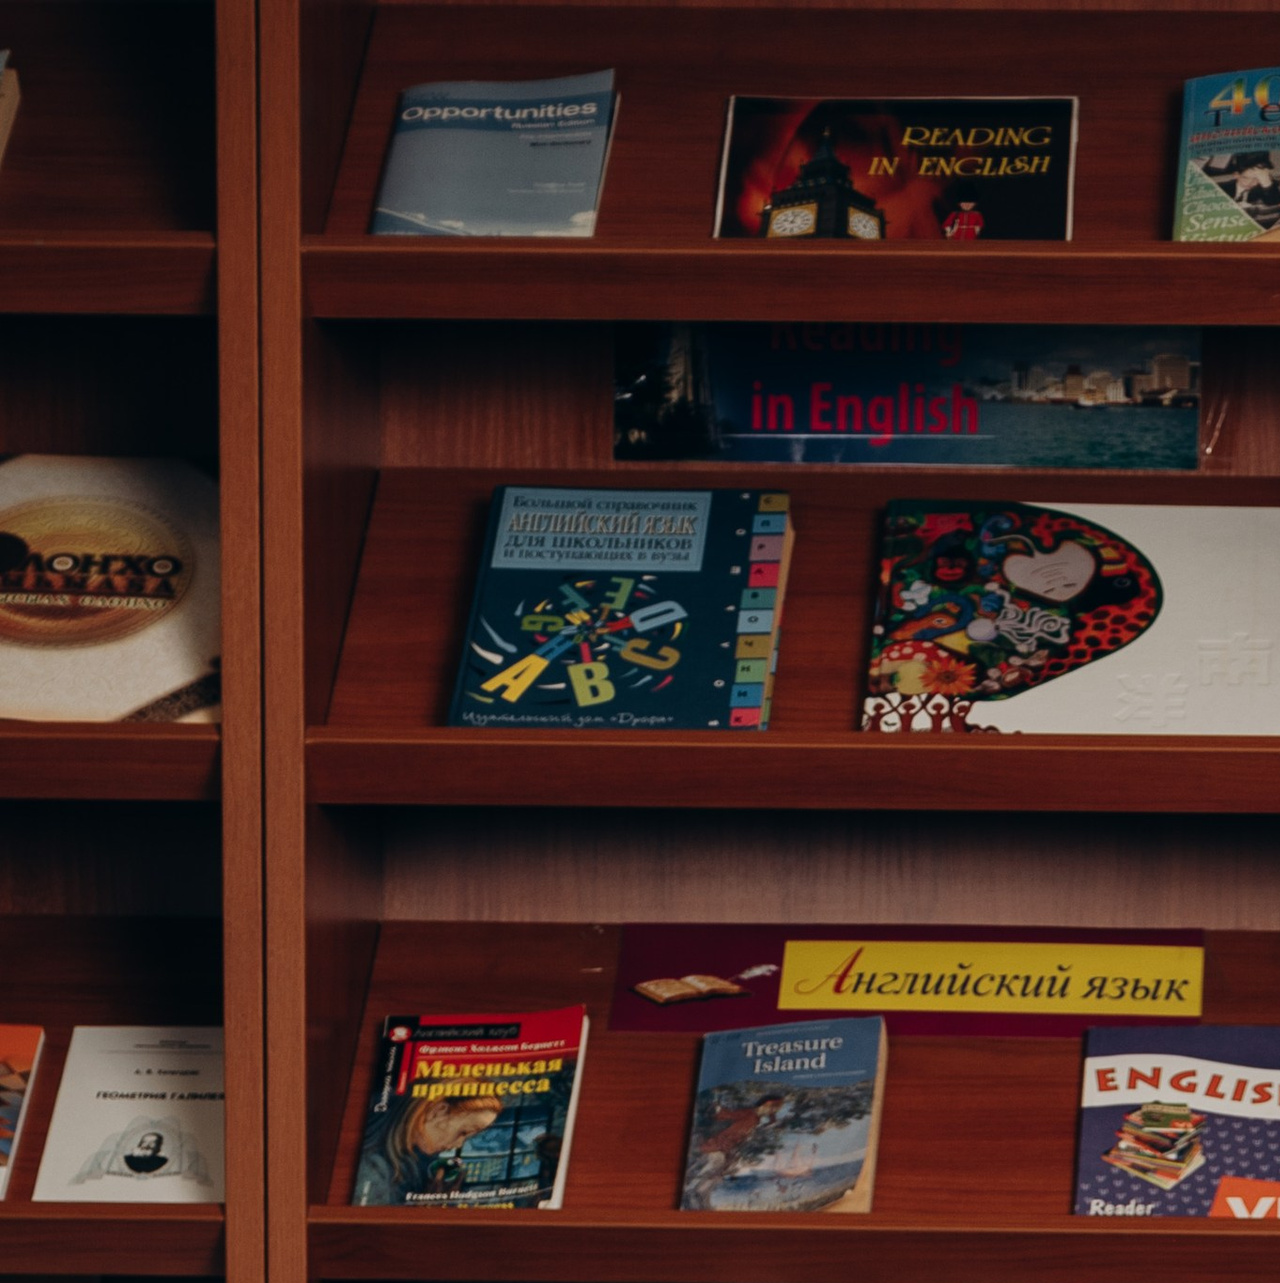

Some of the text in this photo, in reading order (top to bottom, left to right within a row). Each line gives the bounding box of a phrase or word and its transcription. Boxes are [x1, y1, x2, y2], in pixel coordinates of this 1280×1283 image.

[401, 101, 598, 122] Opportunities
[901, 125, 1052, 147] READING
[868, 155, 1052, 176] IN ENGLISH
[771, 322, 964, 367] Reading
[750, 381, 979, 447] in English
[513, 496, 592, 510] Большой
[508, 510, 698, 535] АНГЛИЙСКИЙ ЯЗЫК
[504, 535, 693, 550] ДЛЯ ШКОЛЬНИКОВ
[797, 946, 1190, 1002] Английский язык
[741, 1036, 844, 1058] Treasure
[414, 1057, 564, 1079] Маленькая
[753, 1052, 827, 1074] Island
[411, 1077, 551, 1101] принцесса
[1088, 1199, 1156, 1217] Reader
